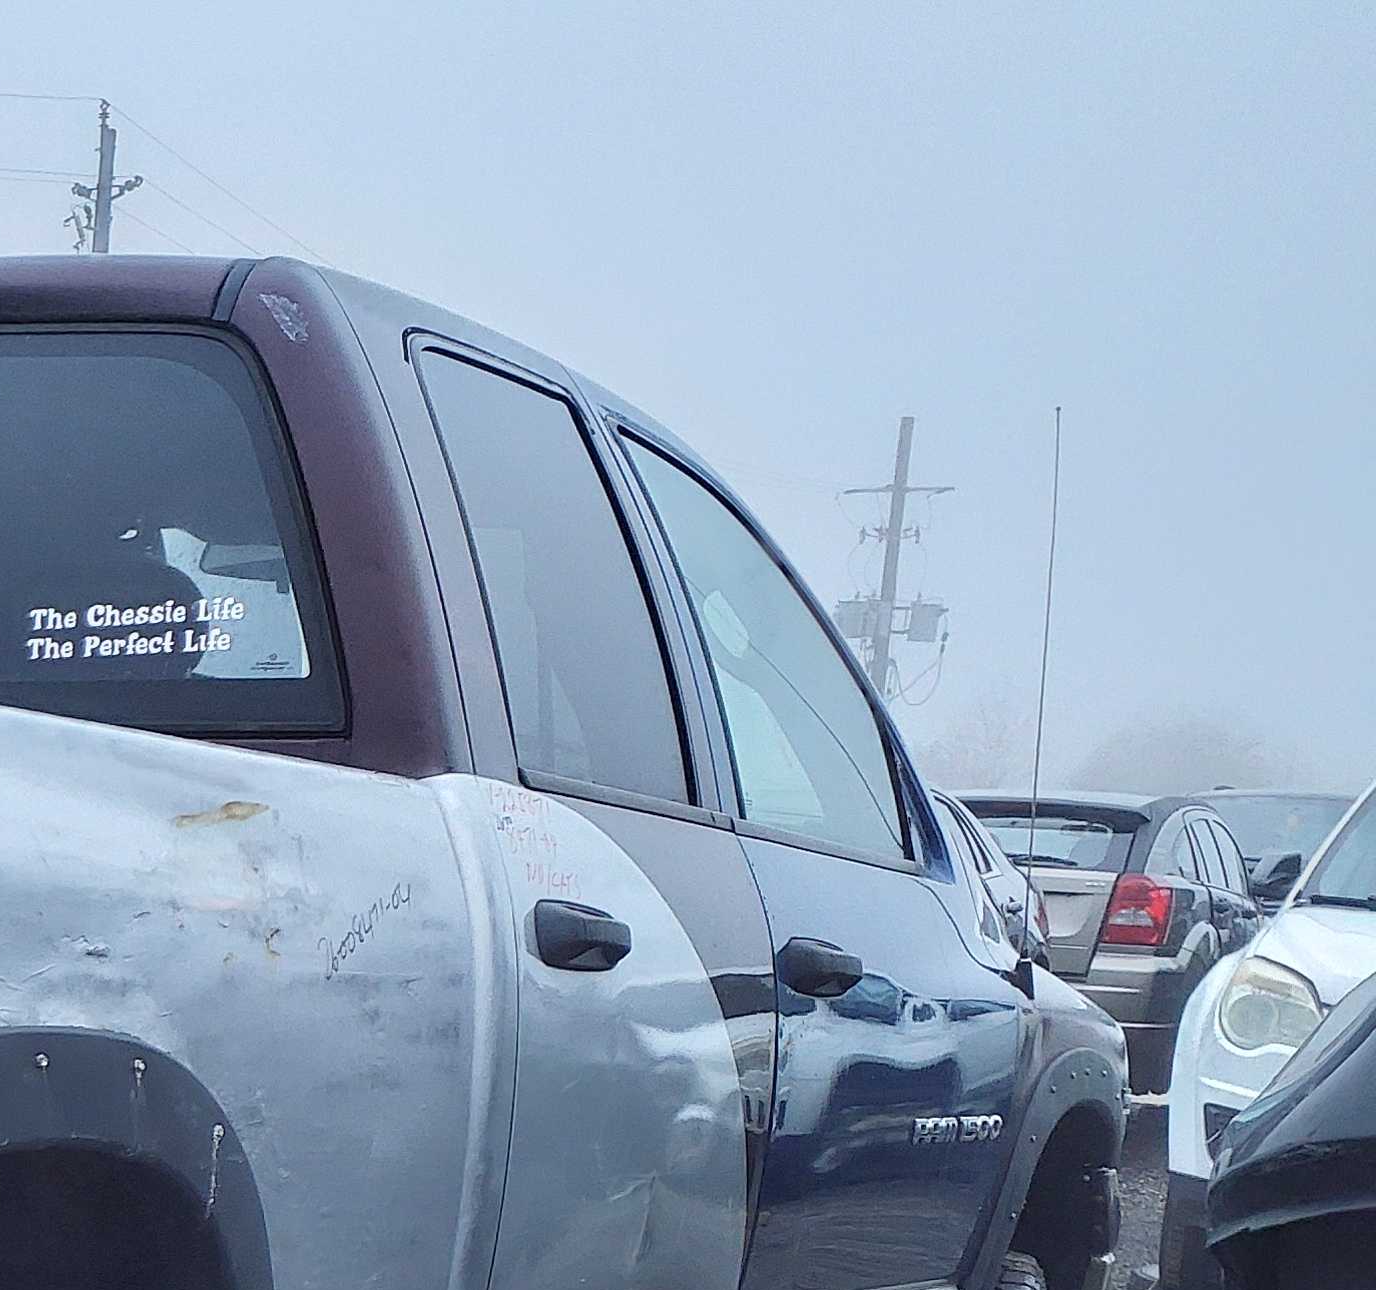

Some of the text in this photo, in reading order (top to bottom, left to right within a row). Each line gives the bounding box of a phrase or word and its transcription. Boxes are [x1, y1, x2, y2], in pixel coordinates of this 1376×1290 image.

[28, 596, 245, 631] The Chessie Life
[26, 627, 232, 660] The Perfect Life
[912, 1112, 1005, 1145] RAM 1500
